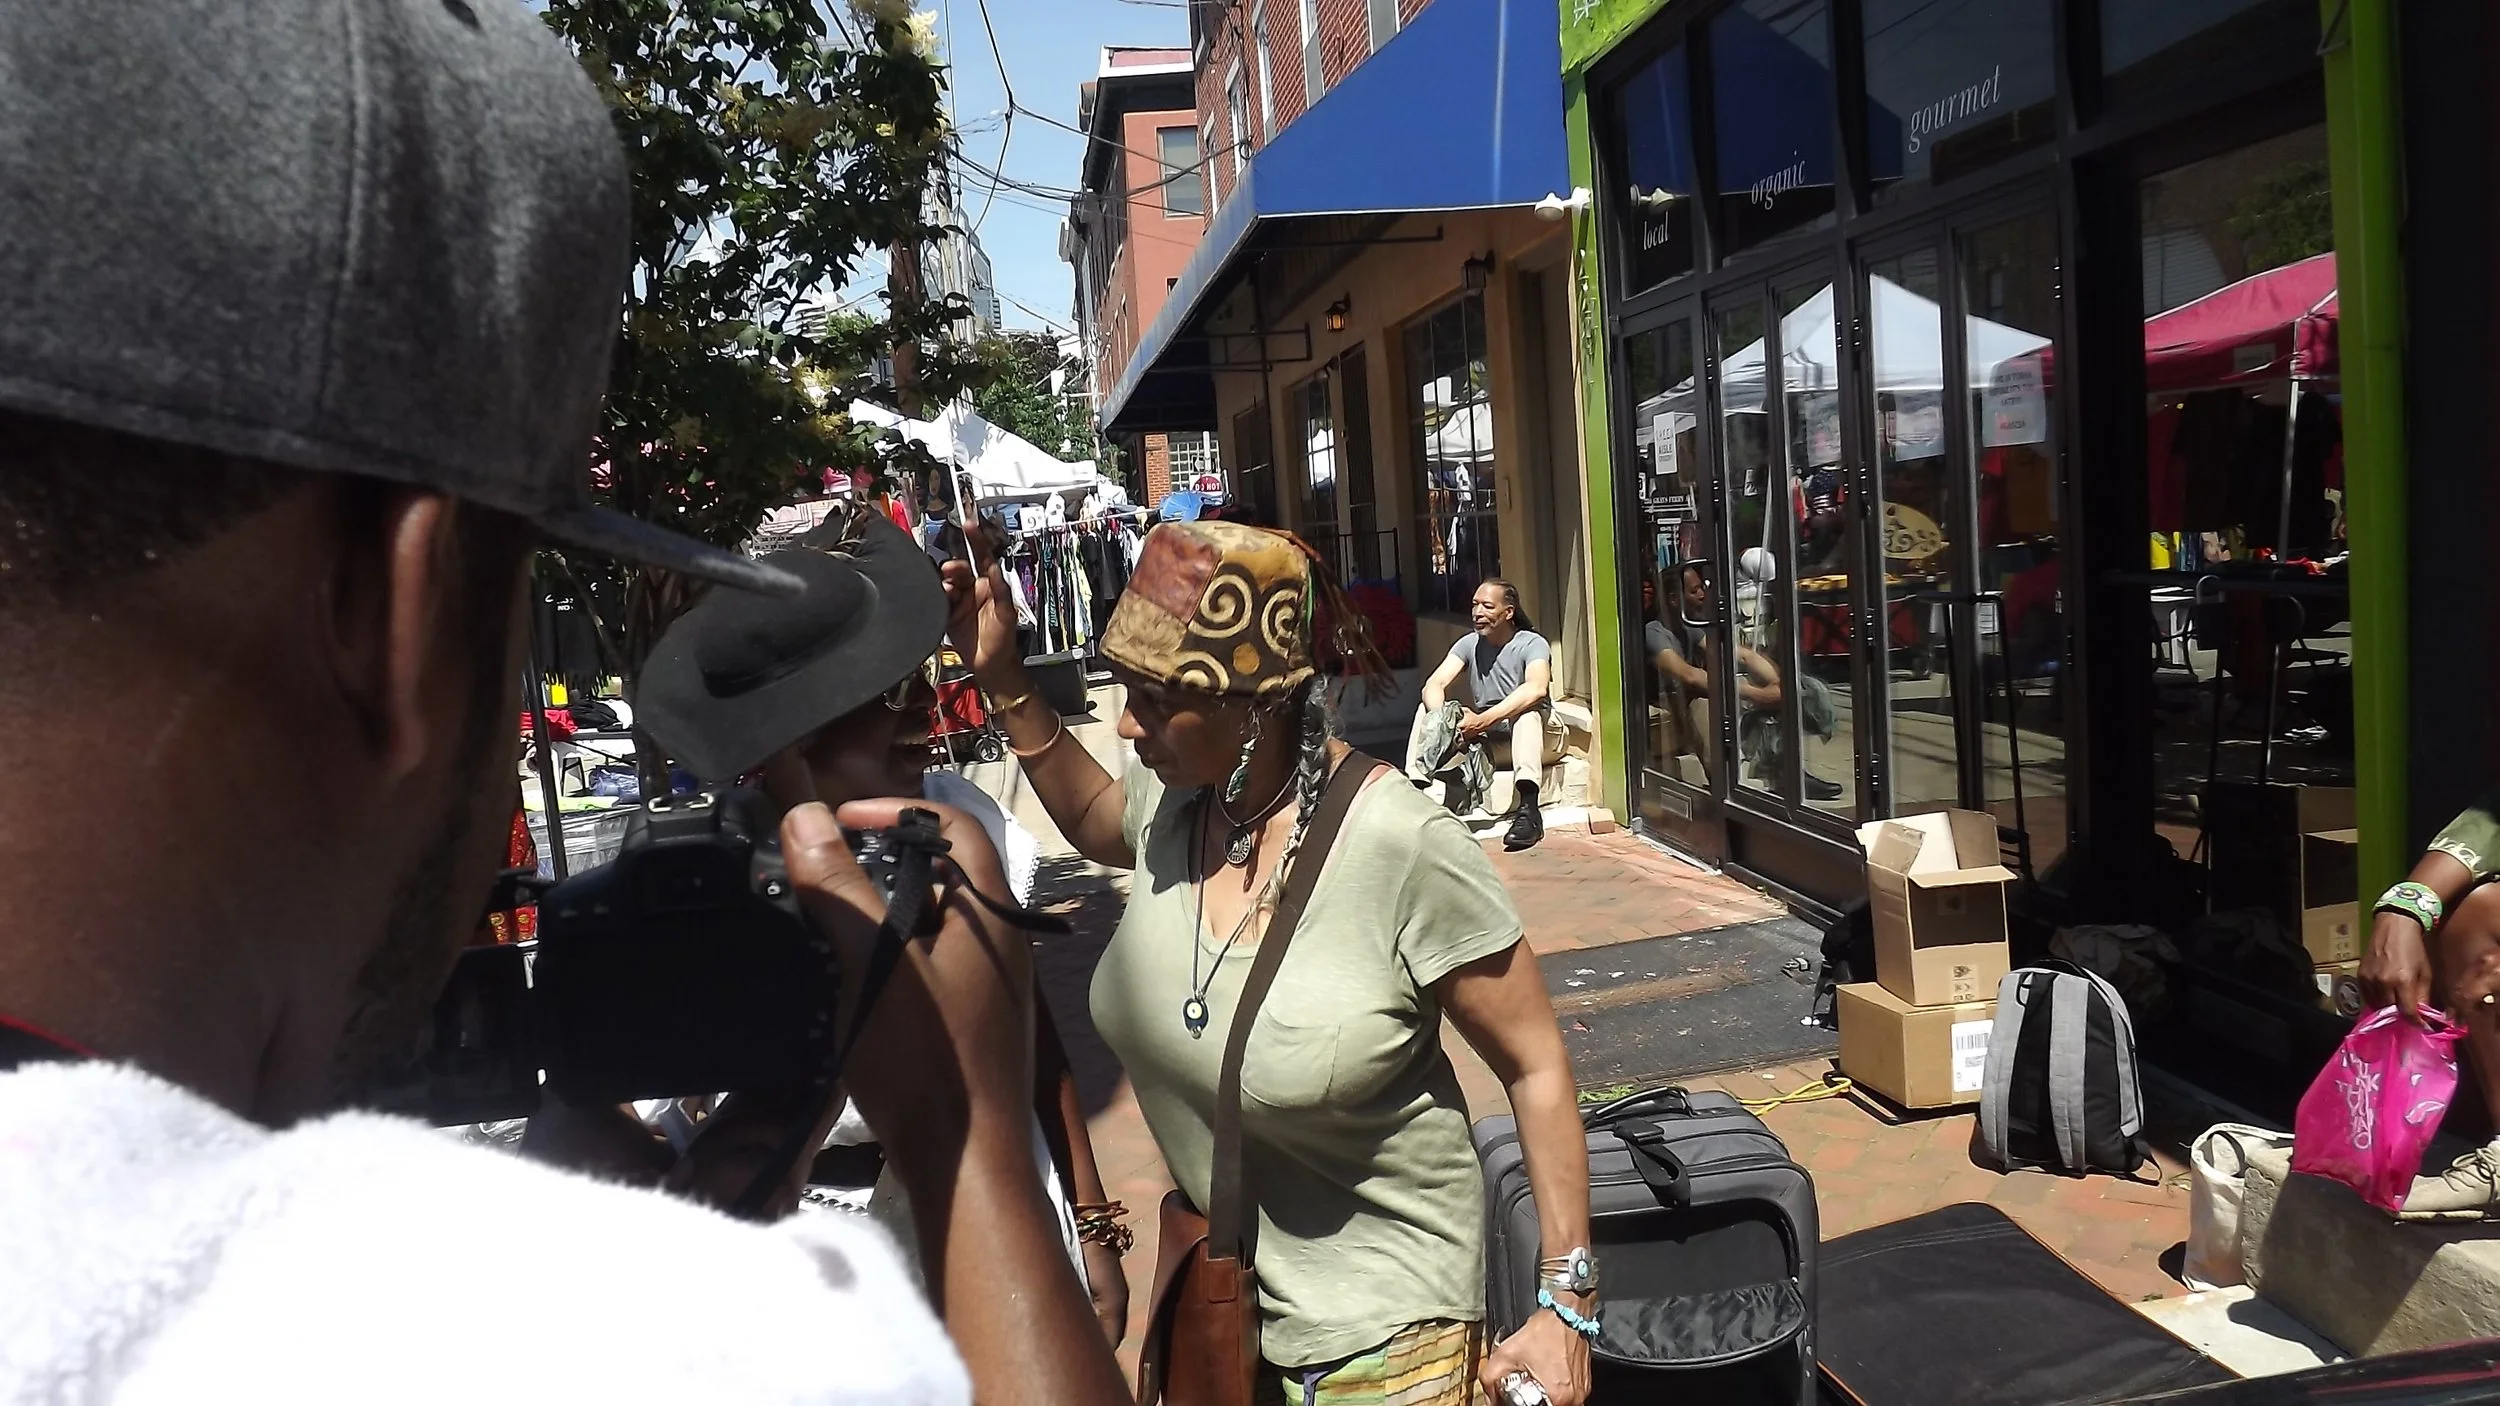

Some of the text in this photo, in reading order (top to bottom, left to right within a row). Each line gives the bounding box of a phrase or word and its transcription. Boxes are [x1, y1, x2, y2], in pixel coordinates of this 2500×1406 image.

[1908, 64, 2000, 153] gourmet
[1751, 149, 1806, 210] organic
[1643, 210, 1669, 250] local
[1206, 482, 1220, 491] NOT
